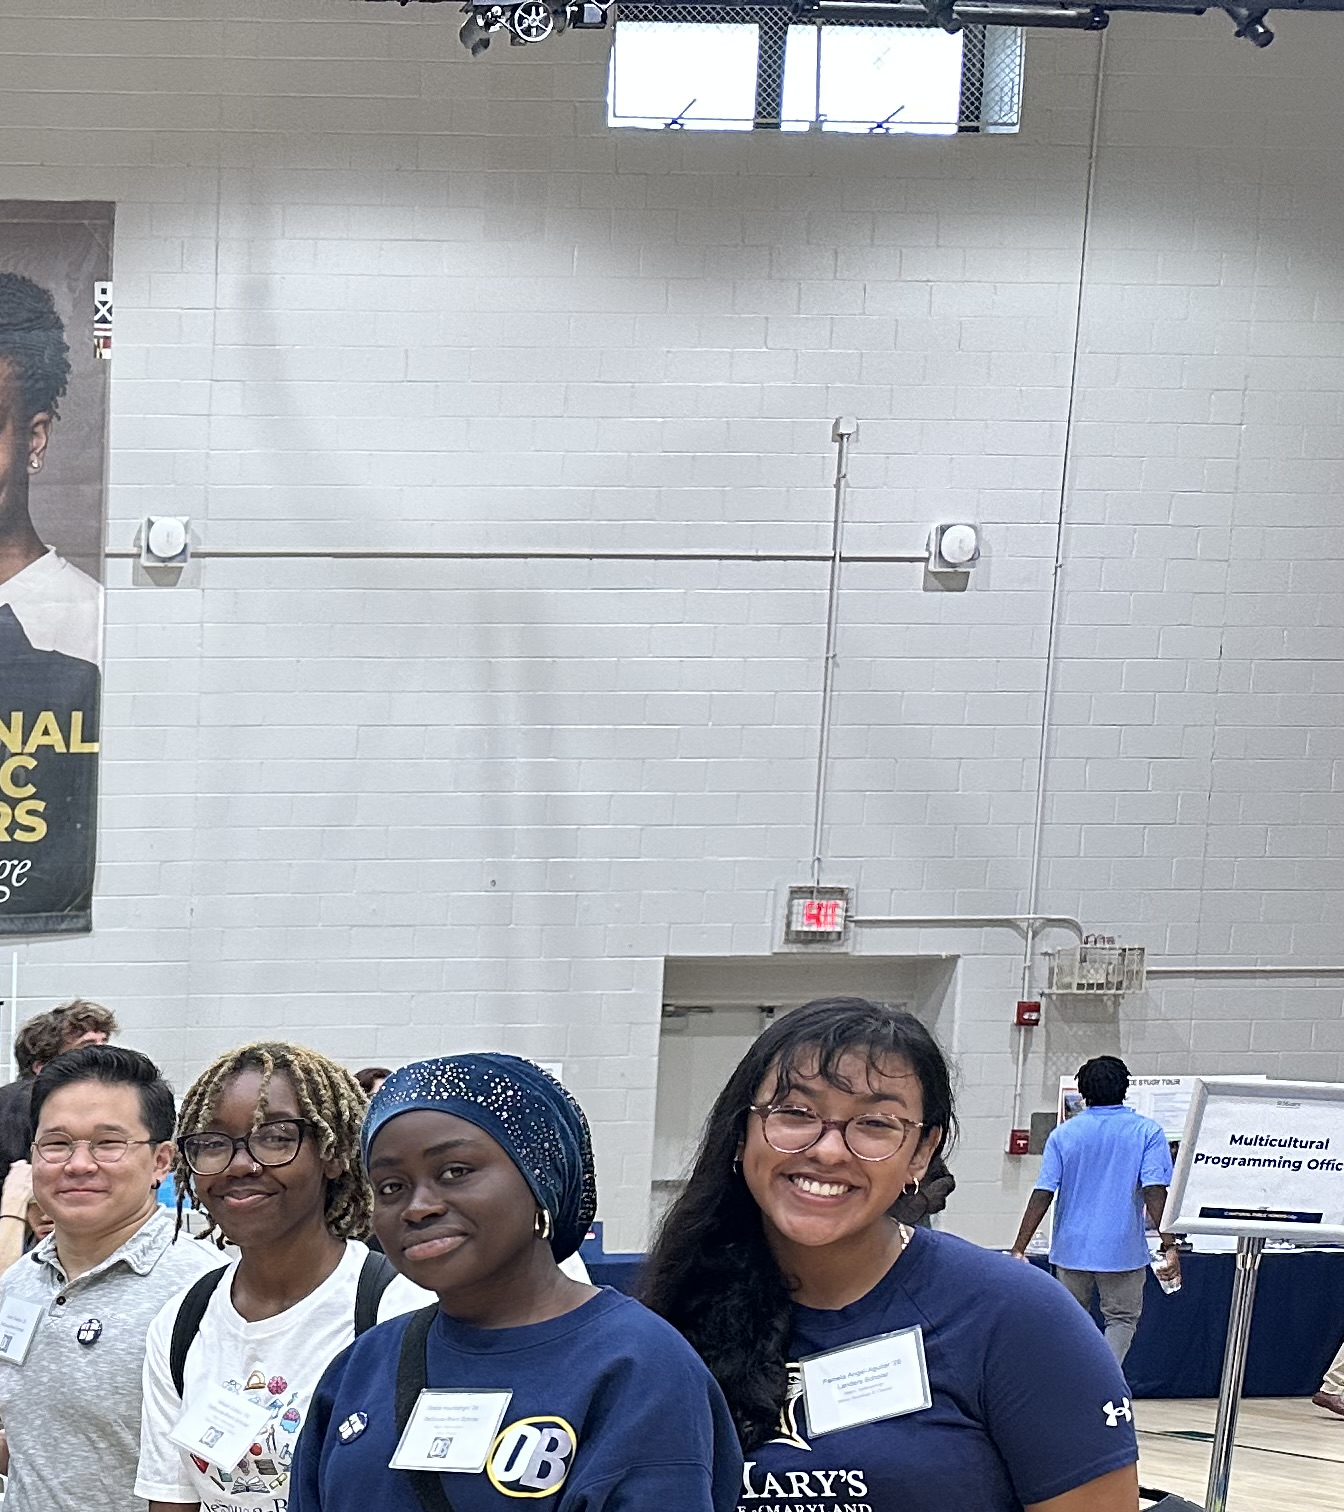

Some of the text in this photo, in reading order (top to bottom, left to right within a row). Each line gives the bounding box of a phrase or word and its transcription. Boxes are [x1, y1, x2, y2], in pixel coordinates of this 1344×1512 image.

[1229, 1134, 1330, 1150] Multicultural
[1194, 1153, 1344, 1172] Programming Offic
